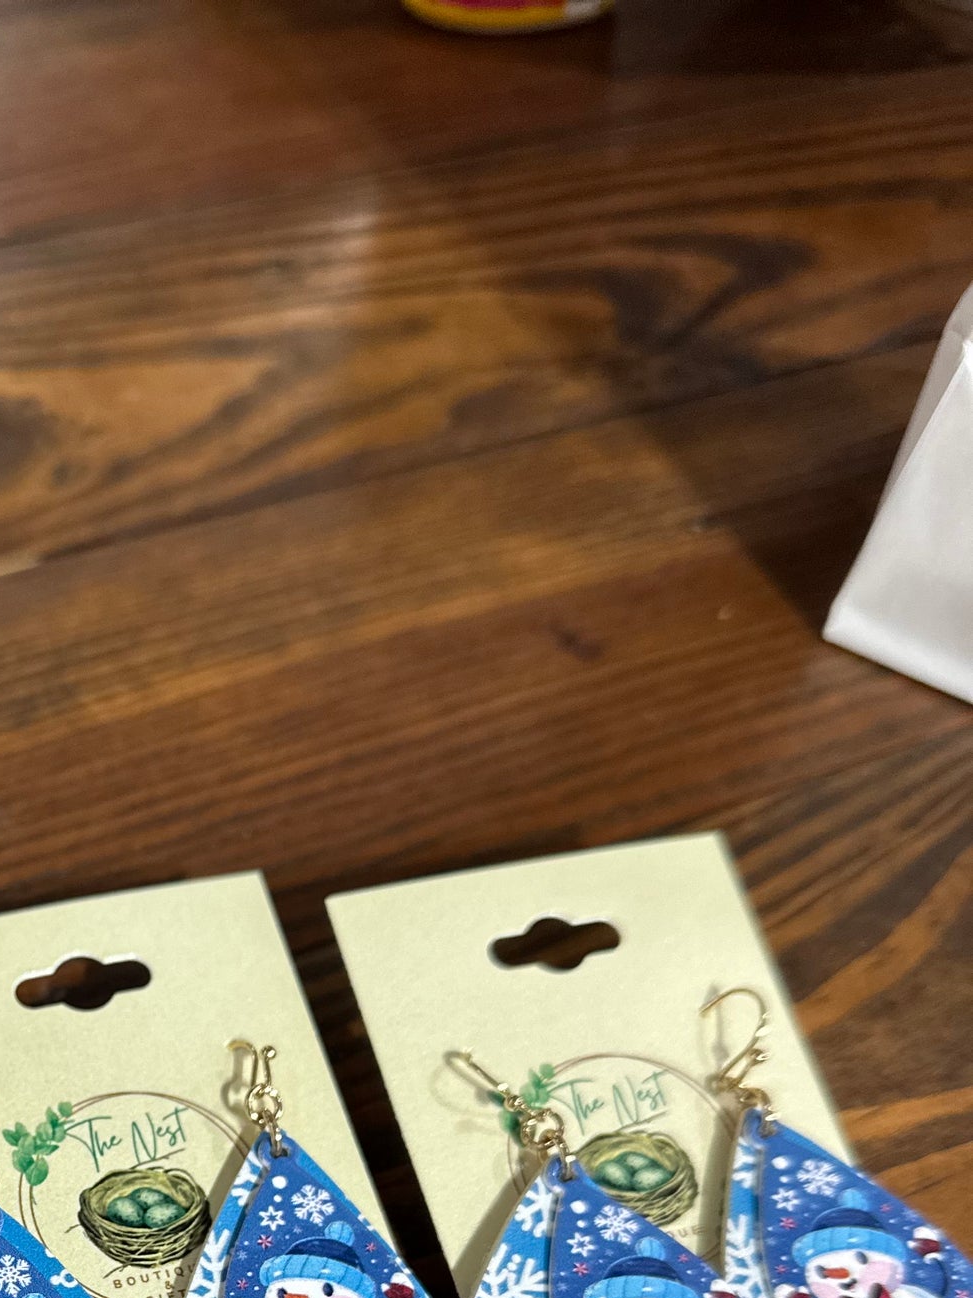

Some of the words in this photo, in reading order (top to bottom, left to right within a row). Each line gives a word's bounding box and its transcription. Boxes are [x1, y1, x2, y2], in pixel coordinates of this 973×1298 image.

[547, 1077, 606, 1136] The
[612, 1069, 669, 1124] Nest
[63, 1116, 123, 1173] The
[131, 1107, 189, 1166] Nest
[113, 1263, 196, 1289] BOUTIQU
[164, 1280, 175, 1290] &
